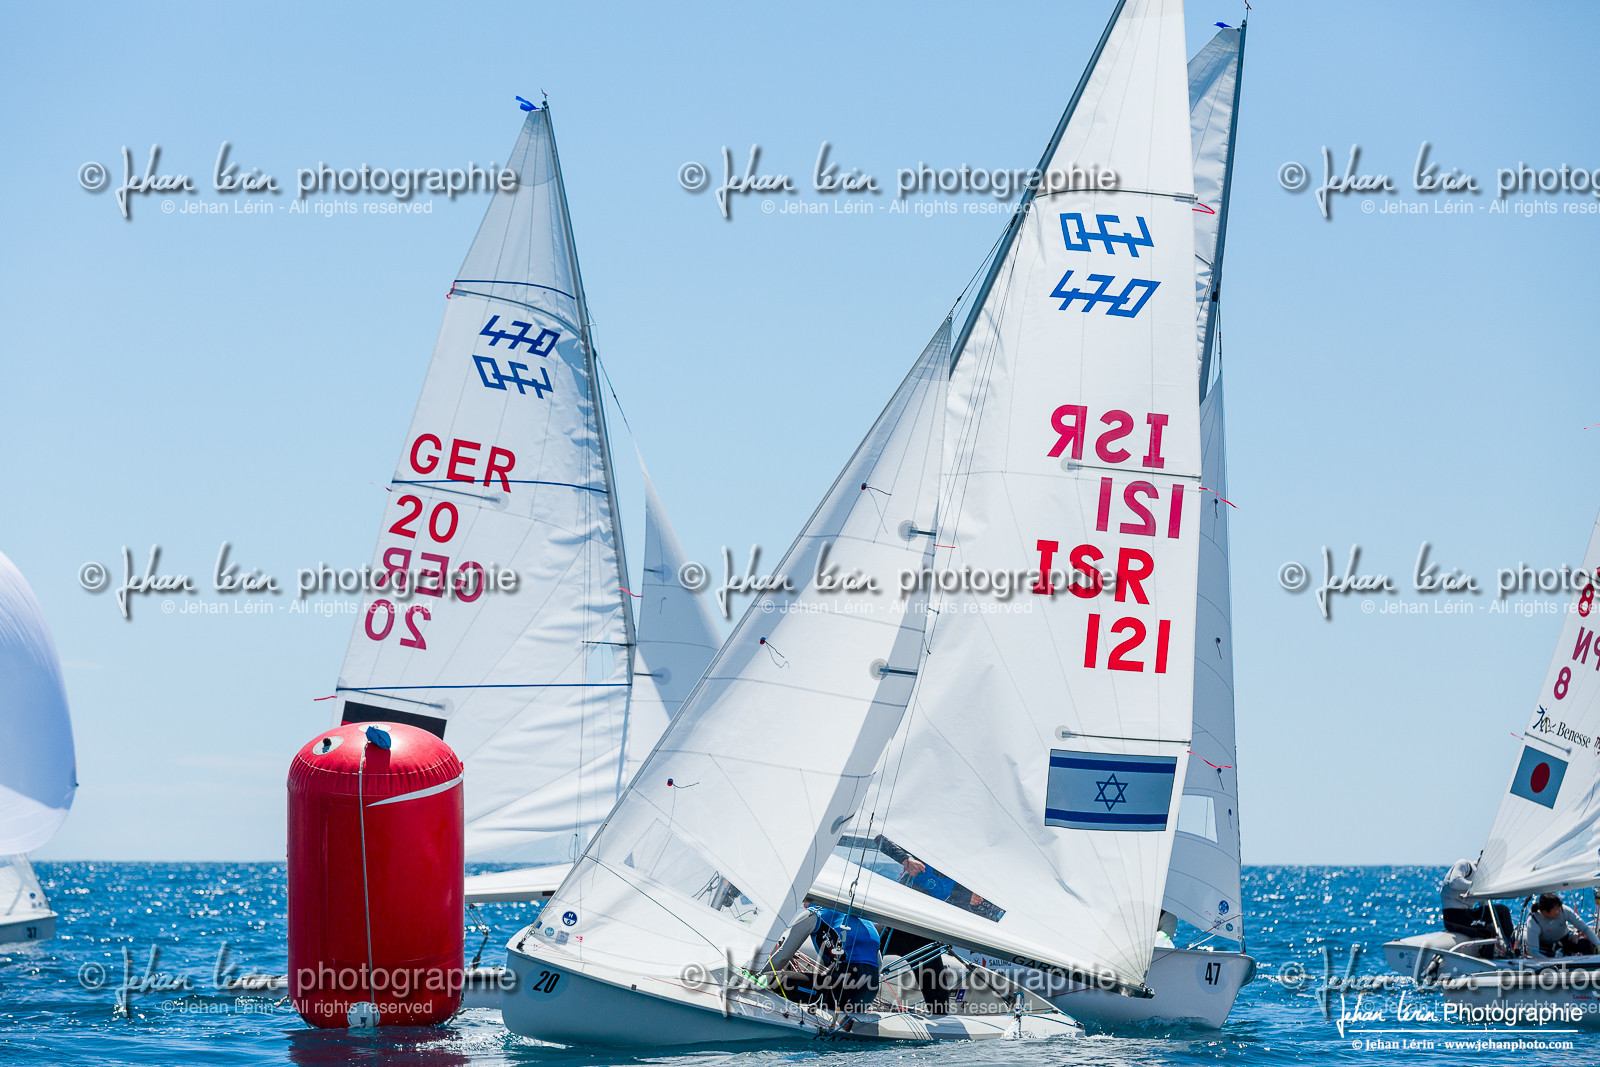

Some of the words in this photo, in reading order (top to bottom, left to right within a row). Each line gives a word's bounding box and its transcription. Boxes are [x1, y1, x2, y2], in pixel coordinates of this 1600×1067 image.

[1049, 270, 1161, 318] 470
[480, 315, 560, 357] 470
[409, 433, 516, 493] GER
[389, 494, 459, 543] 20
[1032, 539, 1154, 605] ISR
[1084, 613, 1171, 673] 121
[1556, 722, 1591, 748] Benesse
[533, 970, 560, 993] 20
[1205, 962, 1221, 985] 47
